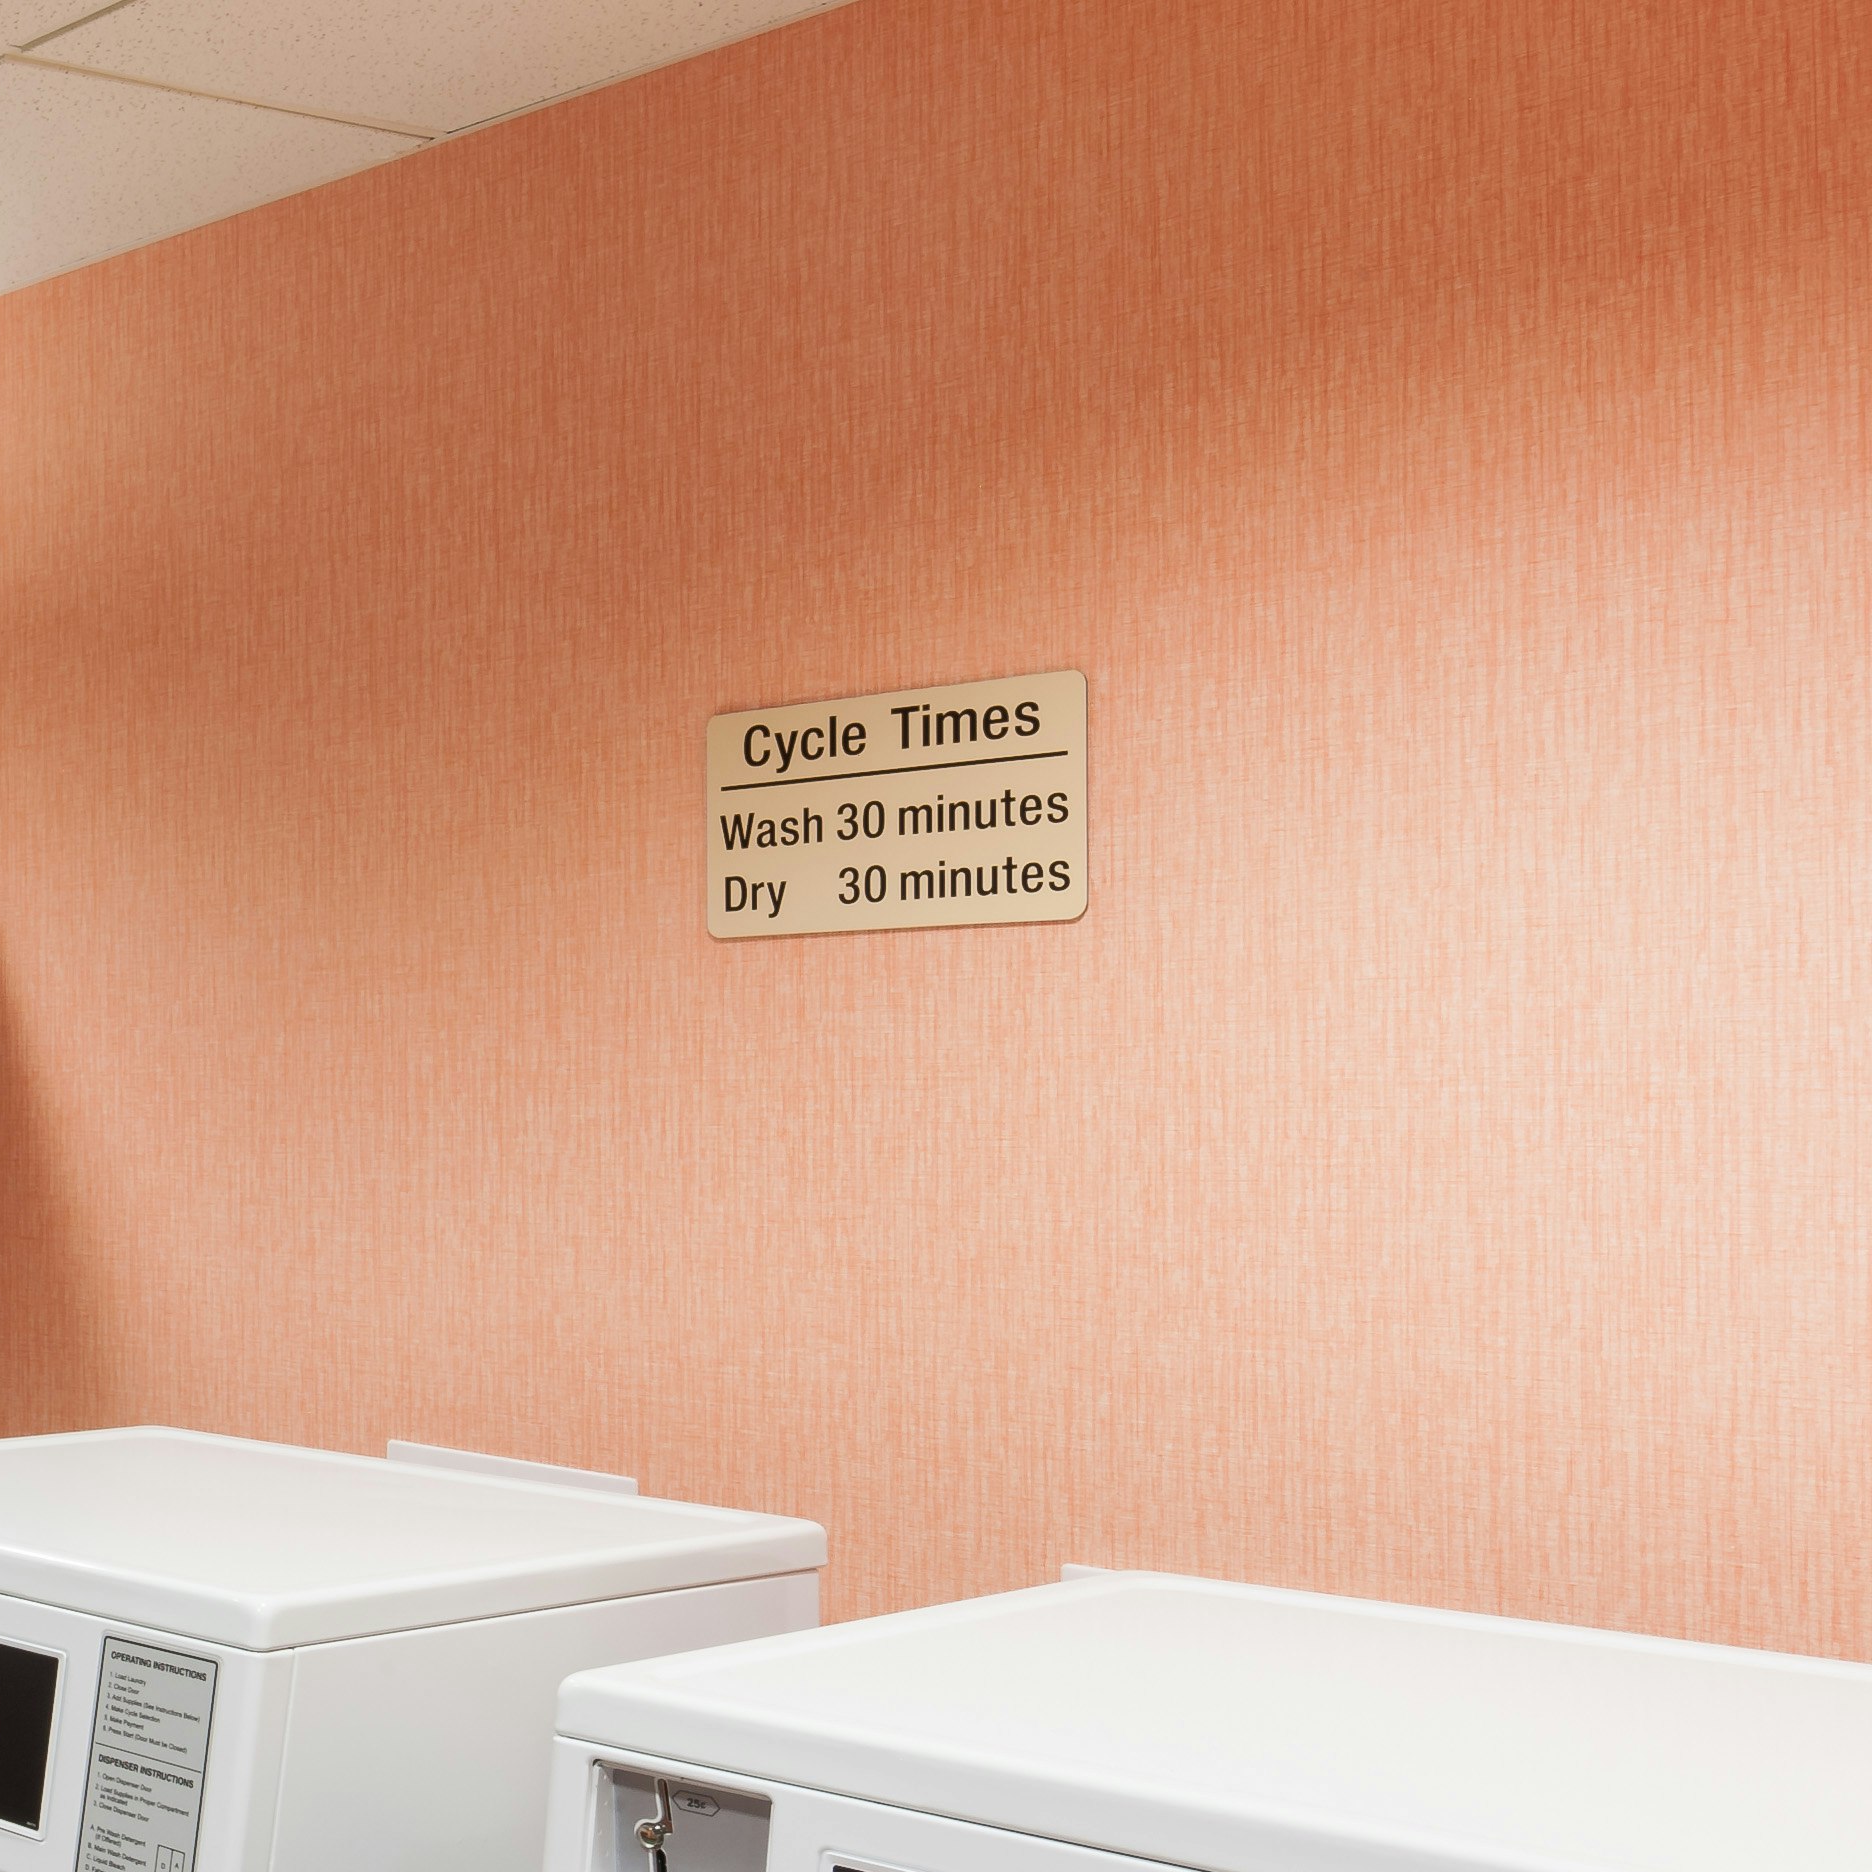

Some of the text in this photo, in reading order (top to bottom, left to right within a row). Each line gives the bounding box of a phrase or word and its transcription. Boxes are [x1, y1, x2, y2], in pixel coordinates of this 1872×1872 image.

[743, 700, 1041, 774] Cycle Times
[720, 789, 1068, 850] Wash 30 minutes
[724, 856, 1070, 918] Dry 30 minutes
[111, 1651, 207, 1682] OPERATING INSTRUCTIONS
[98, 1754, 194, 1789] DISPENSER INSTRUCTIONS
